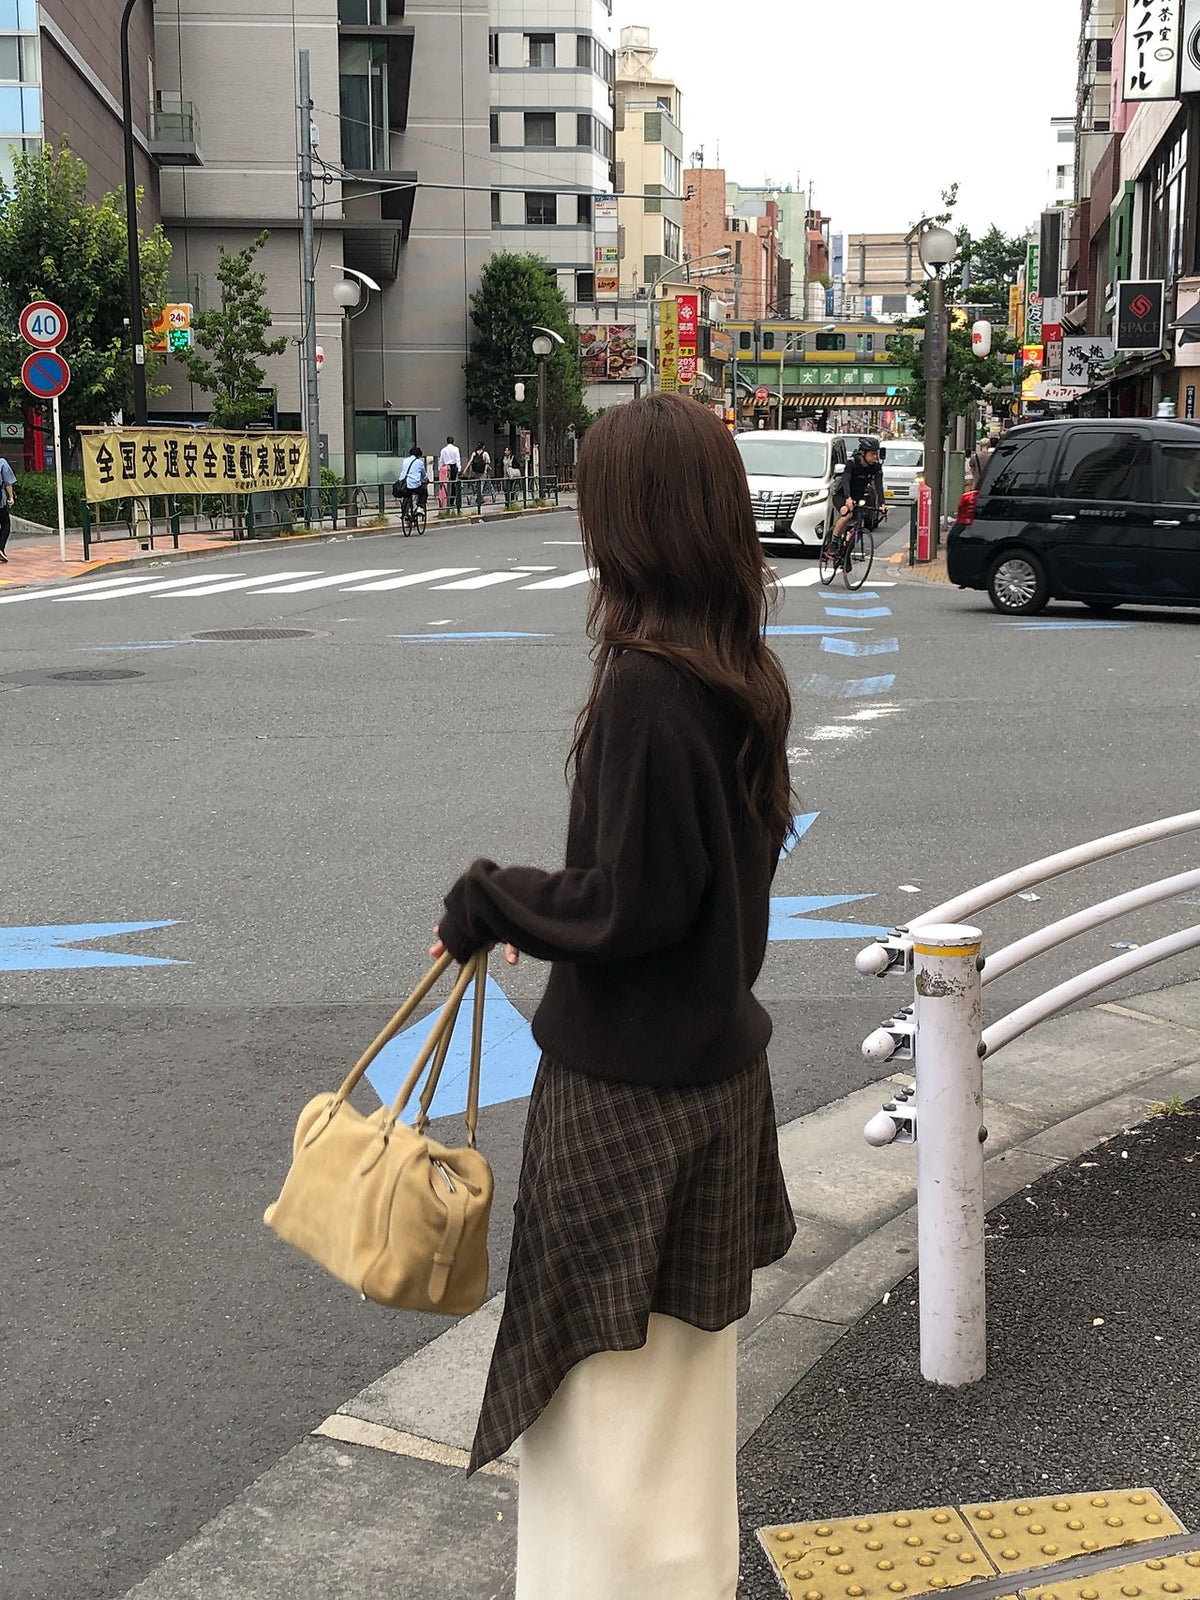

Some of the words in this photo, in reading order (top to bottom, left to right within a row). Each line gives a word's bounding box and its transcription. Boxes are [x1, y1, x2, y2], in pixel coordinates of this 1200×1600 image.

[1157, 0, 1174, 41] 茶室
[31, 314, 57, 336] 40
[1120, 320, 1160, 333] SPACE
[802, 372, 874, 384] 大久保駅
[96, 440, 300, 483] 全国交通安全運動実施中
